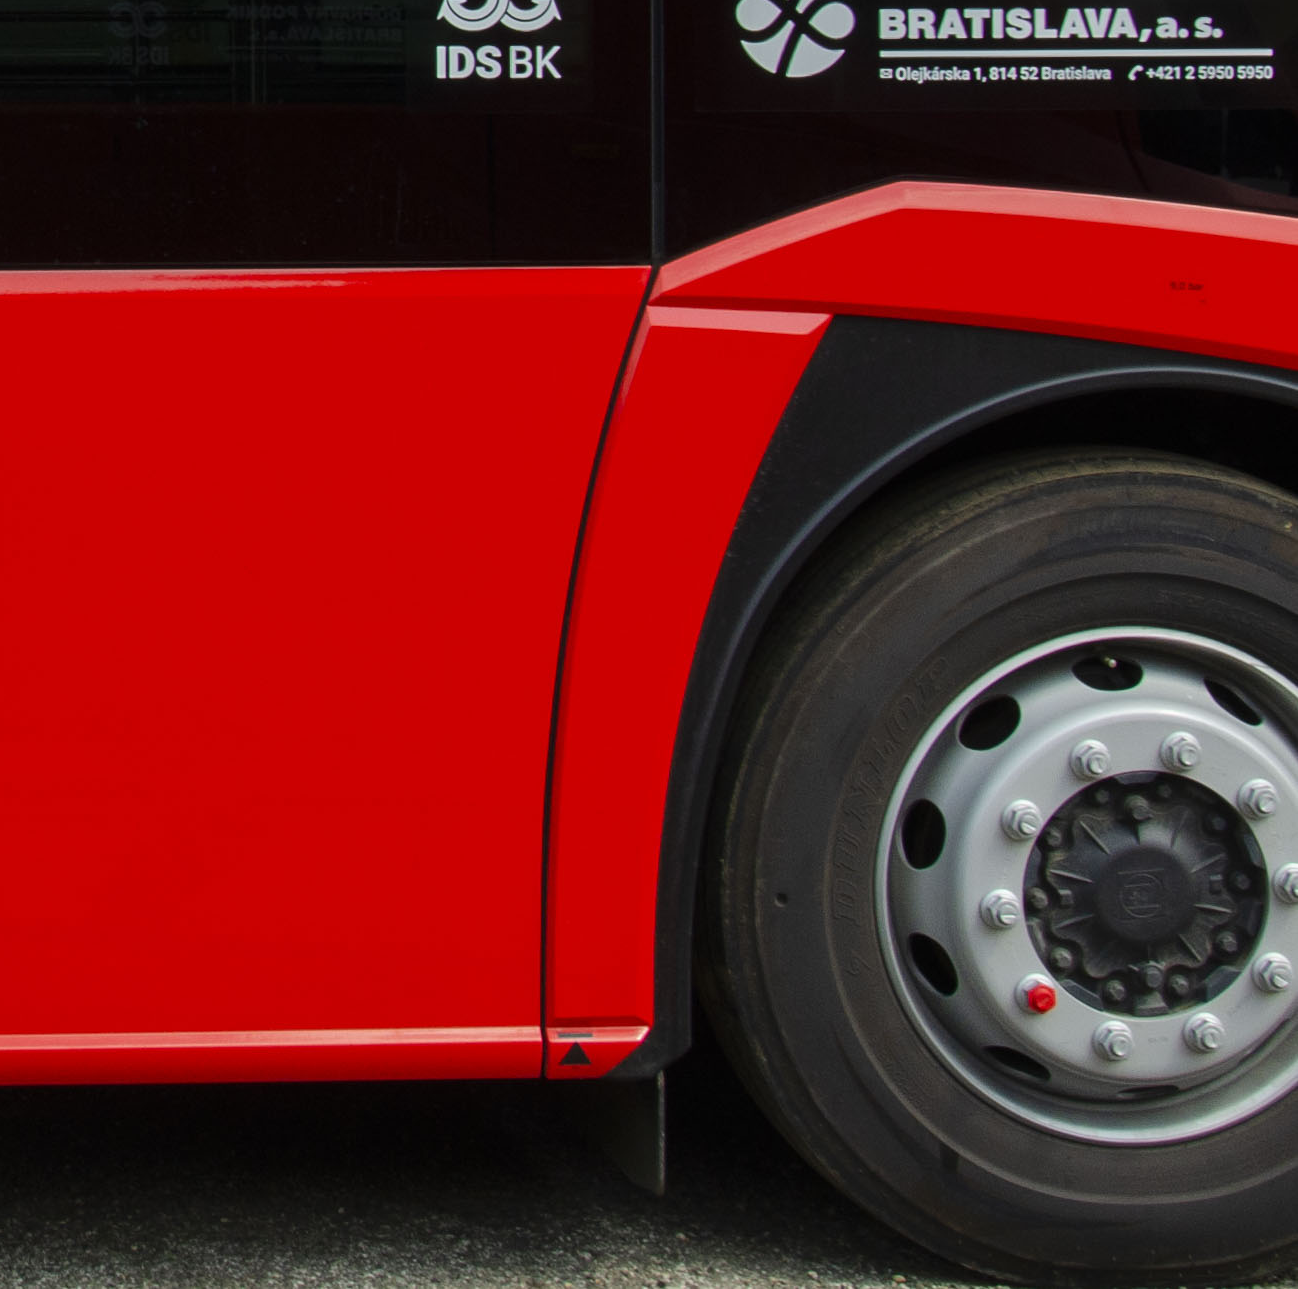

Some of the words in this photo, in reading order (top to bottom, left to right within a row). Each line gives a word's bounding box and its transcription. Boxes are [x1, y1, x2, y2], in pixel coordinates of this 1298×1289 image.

[435, 45, 503, 80] IDS
[509, 45, 562, 79] BK
[894, 65, 971, 84] Olejkárska
[973, 66, 988, 83] 1,
[989, 66, 1018, 81] 814
[1020, 66, 1040, 81] 52
[1041, 65, 1113, 81] Bratislava
[1145, 65, 1182, 81] +421
[1184, 65, 1196, 80] 2
[1198, 65, 1235, 80] 5950
[1236, 64, 1275, 80] 5950
